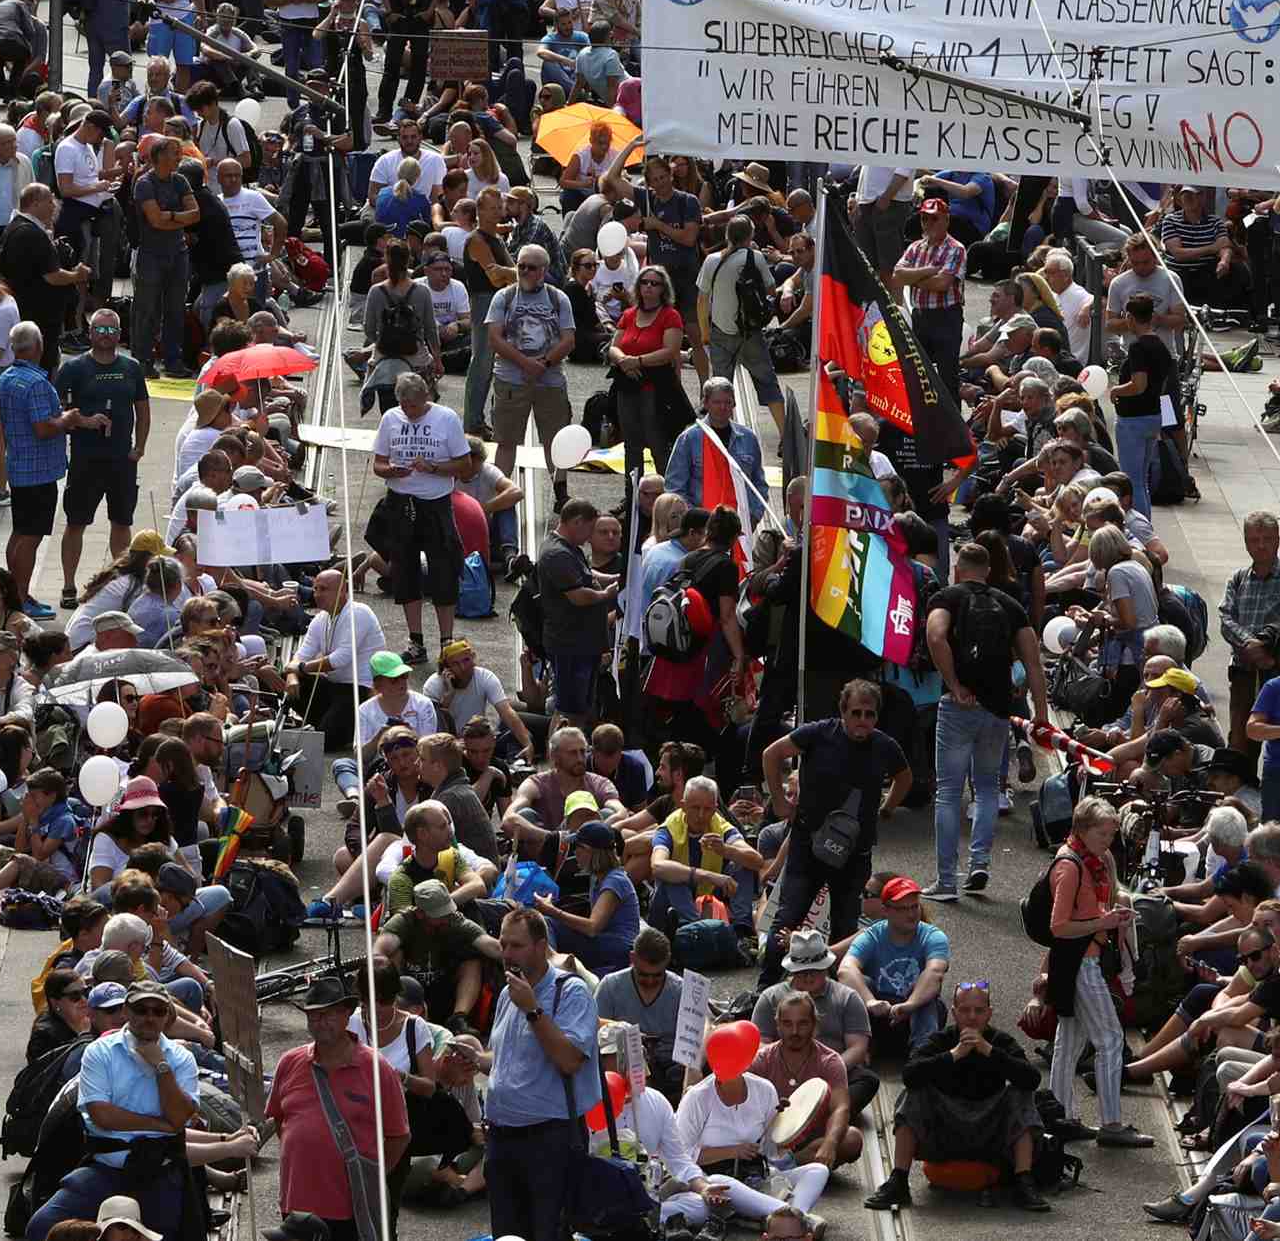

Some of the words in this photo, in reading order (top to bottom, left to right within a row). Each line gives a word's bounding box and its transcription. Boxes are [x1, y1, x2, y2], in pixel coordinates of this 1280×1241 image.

[704, 20, 895, 65] SUPERREICHER
[791, 67, 880, 107] FÜHREN
[718, 108, 798, 148] MEINE
[814, 112, 920, 156] REICHE
[938, 121, 1061, 165] KLASSE
[1180, 110, 1263, 174] NO
[400, 424, 432, 436] NYC
[845, 503, 896, 535] PAIX
